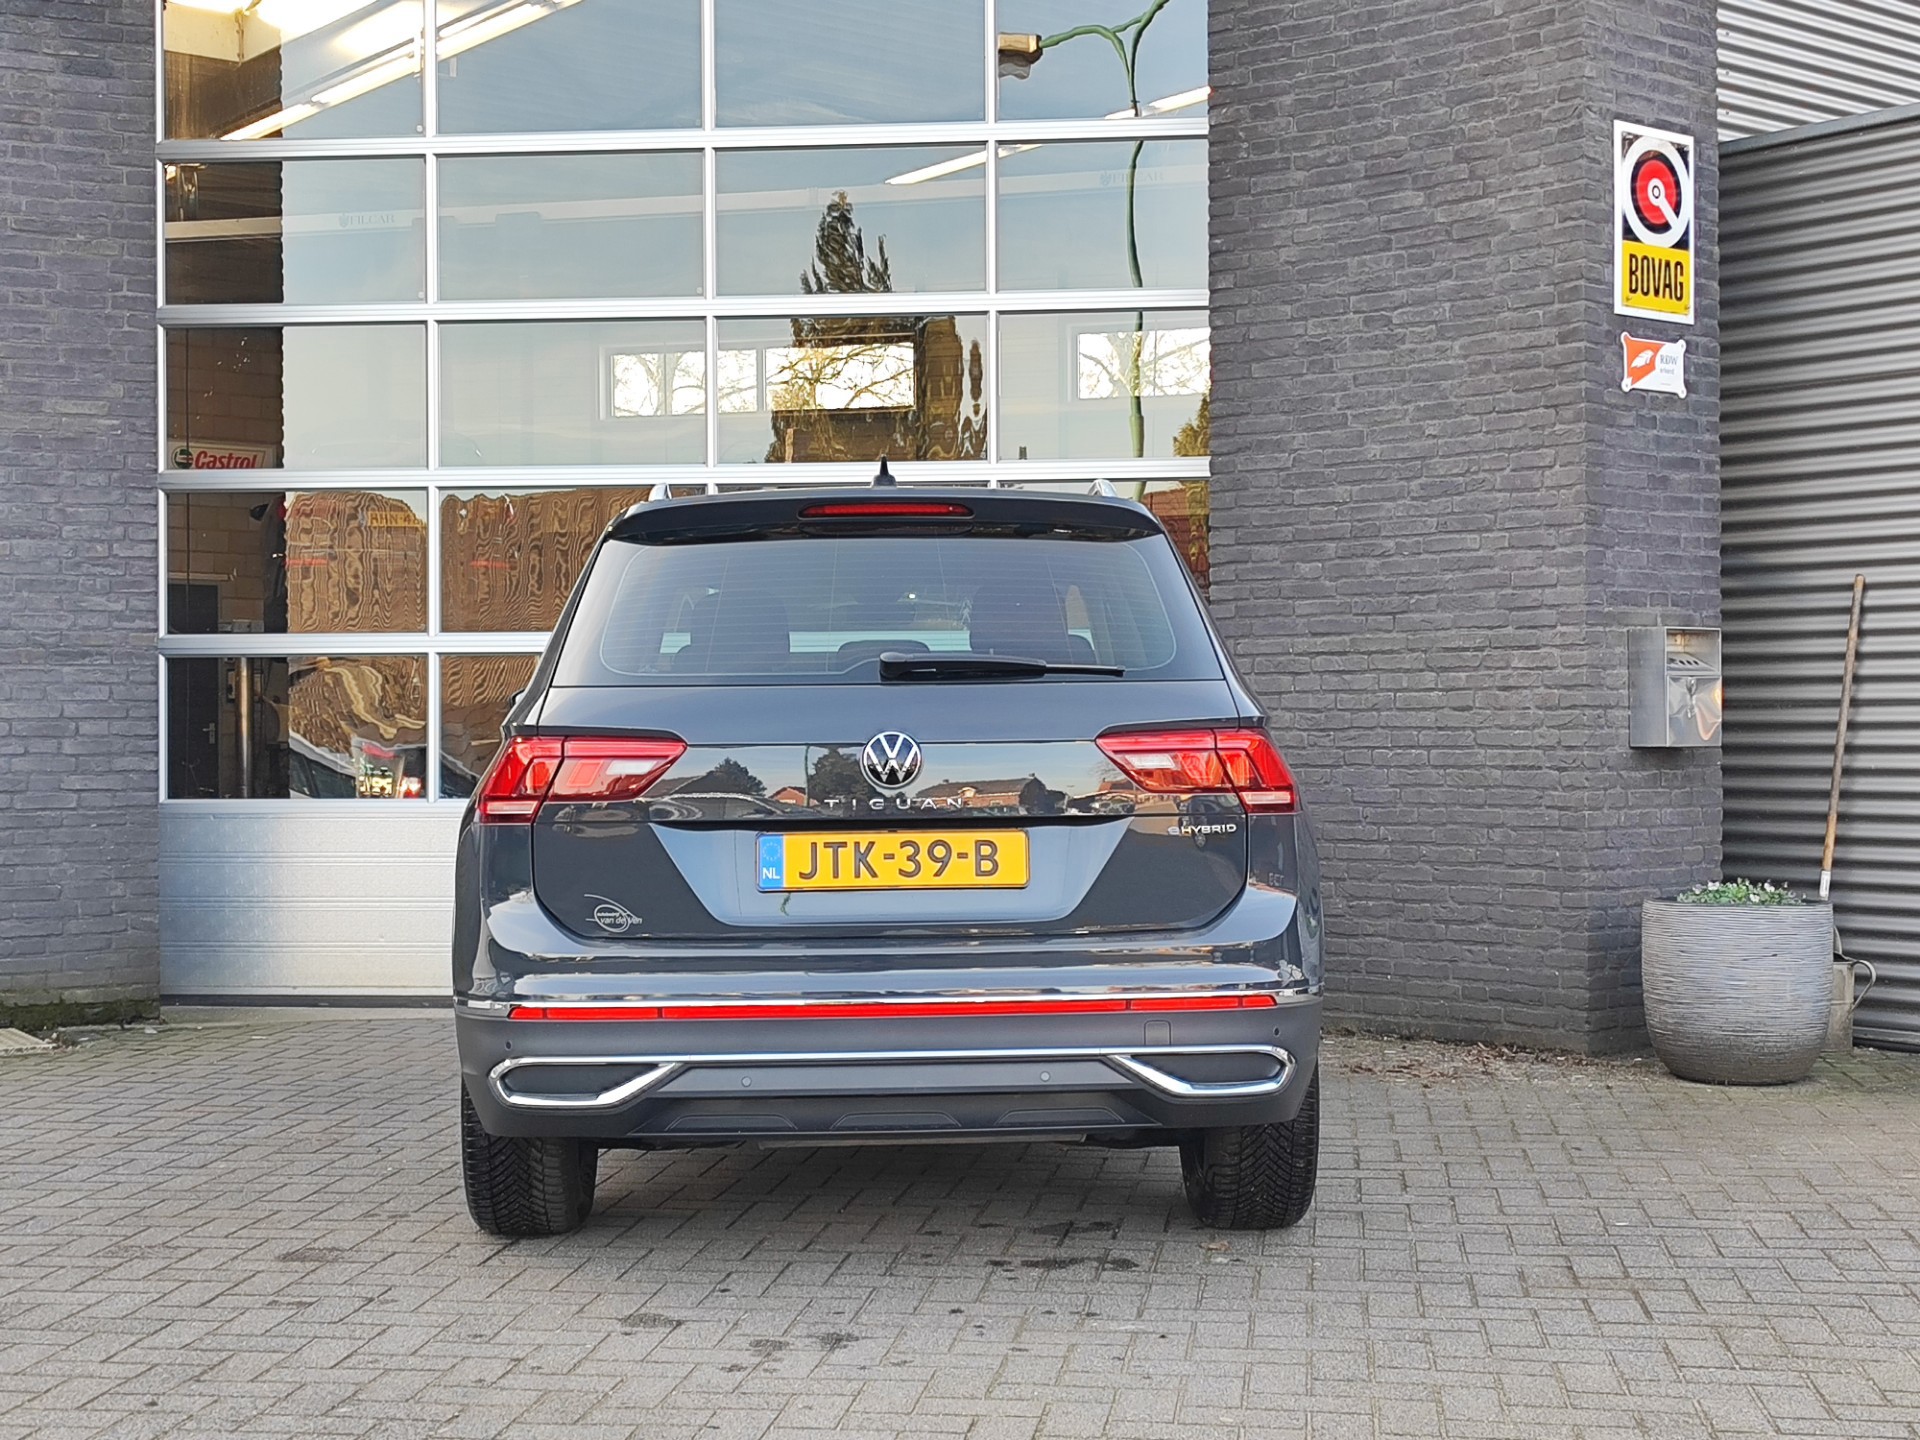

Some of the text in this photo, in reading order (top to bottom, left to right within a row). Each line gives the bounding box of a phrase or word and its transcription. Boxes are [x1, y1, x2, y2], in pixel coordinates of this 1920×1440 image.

[1629, 253, 1684, 302] BOVAG
[1660, 354, 1678, 365] RDW
[194, 450, 257, 469] Castrol
[824, 798, 963, 810] TIGUAN
[798, 839, 999, 880] JTK-39-B
[762, 867, 780, 879] NL
[600, 917, 614, 925] van
